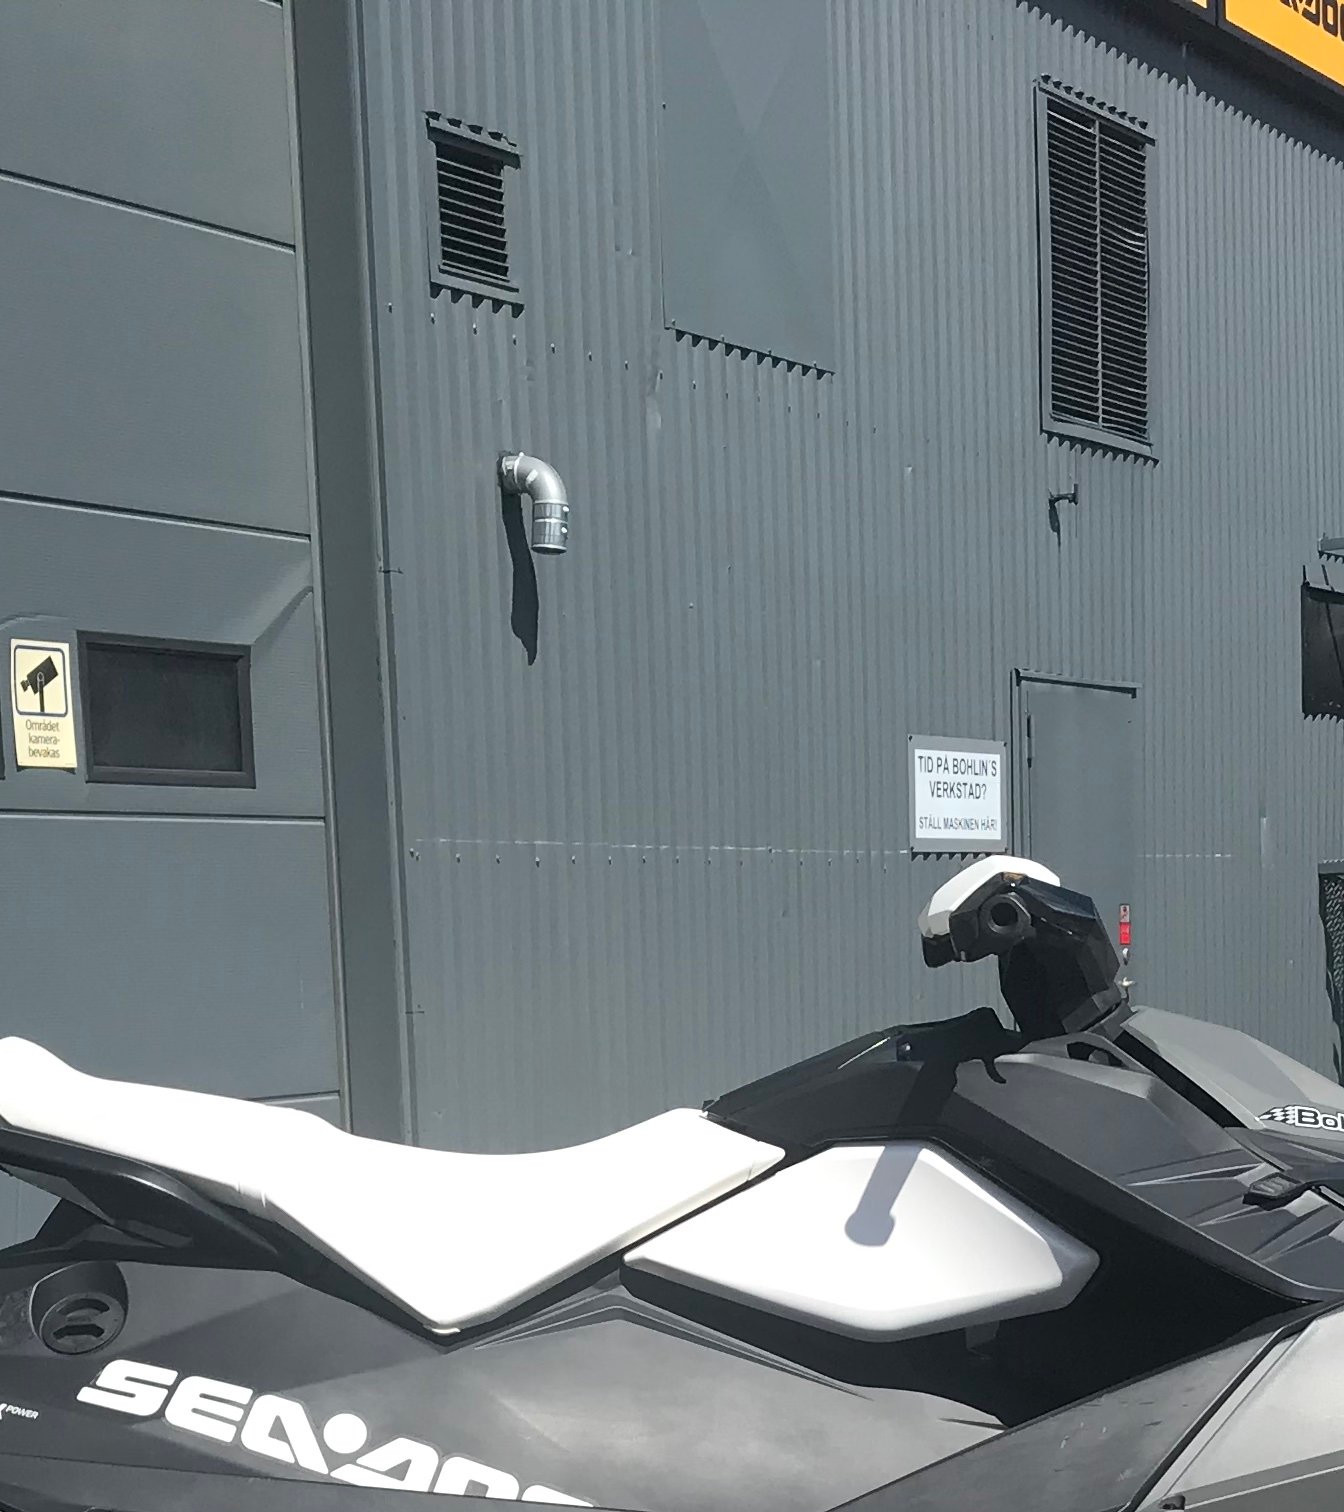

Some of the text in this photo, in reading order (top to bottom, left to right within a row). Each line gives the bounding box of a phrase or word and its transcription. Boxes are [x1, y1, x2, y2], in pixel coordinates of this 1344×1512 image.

[25, 719, 60, 732] Området
[28, 732, 60, 745] kamera-
[28, 746, 60, 758] bevakas
[917, 756, 934, 773] TID
[936, 754, 950, 774] PÅ
[929, 781, 987, 800] VERKSTAD?
[919, 814, 942, 830] STÄLL
[943, 816, 979, 831] MASKINEN
[5, 1404, 39, 1420] POWER
